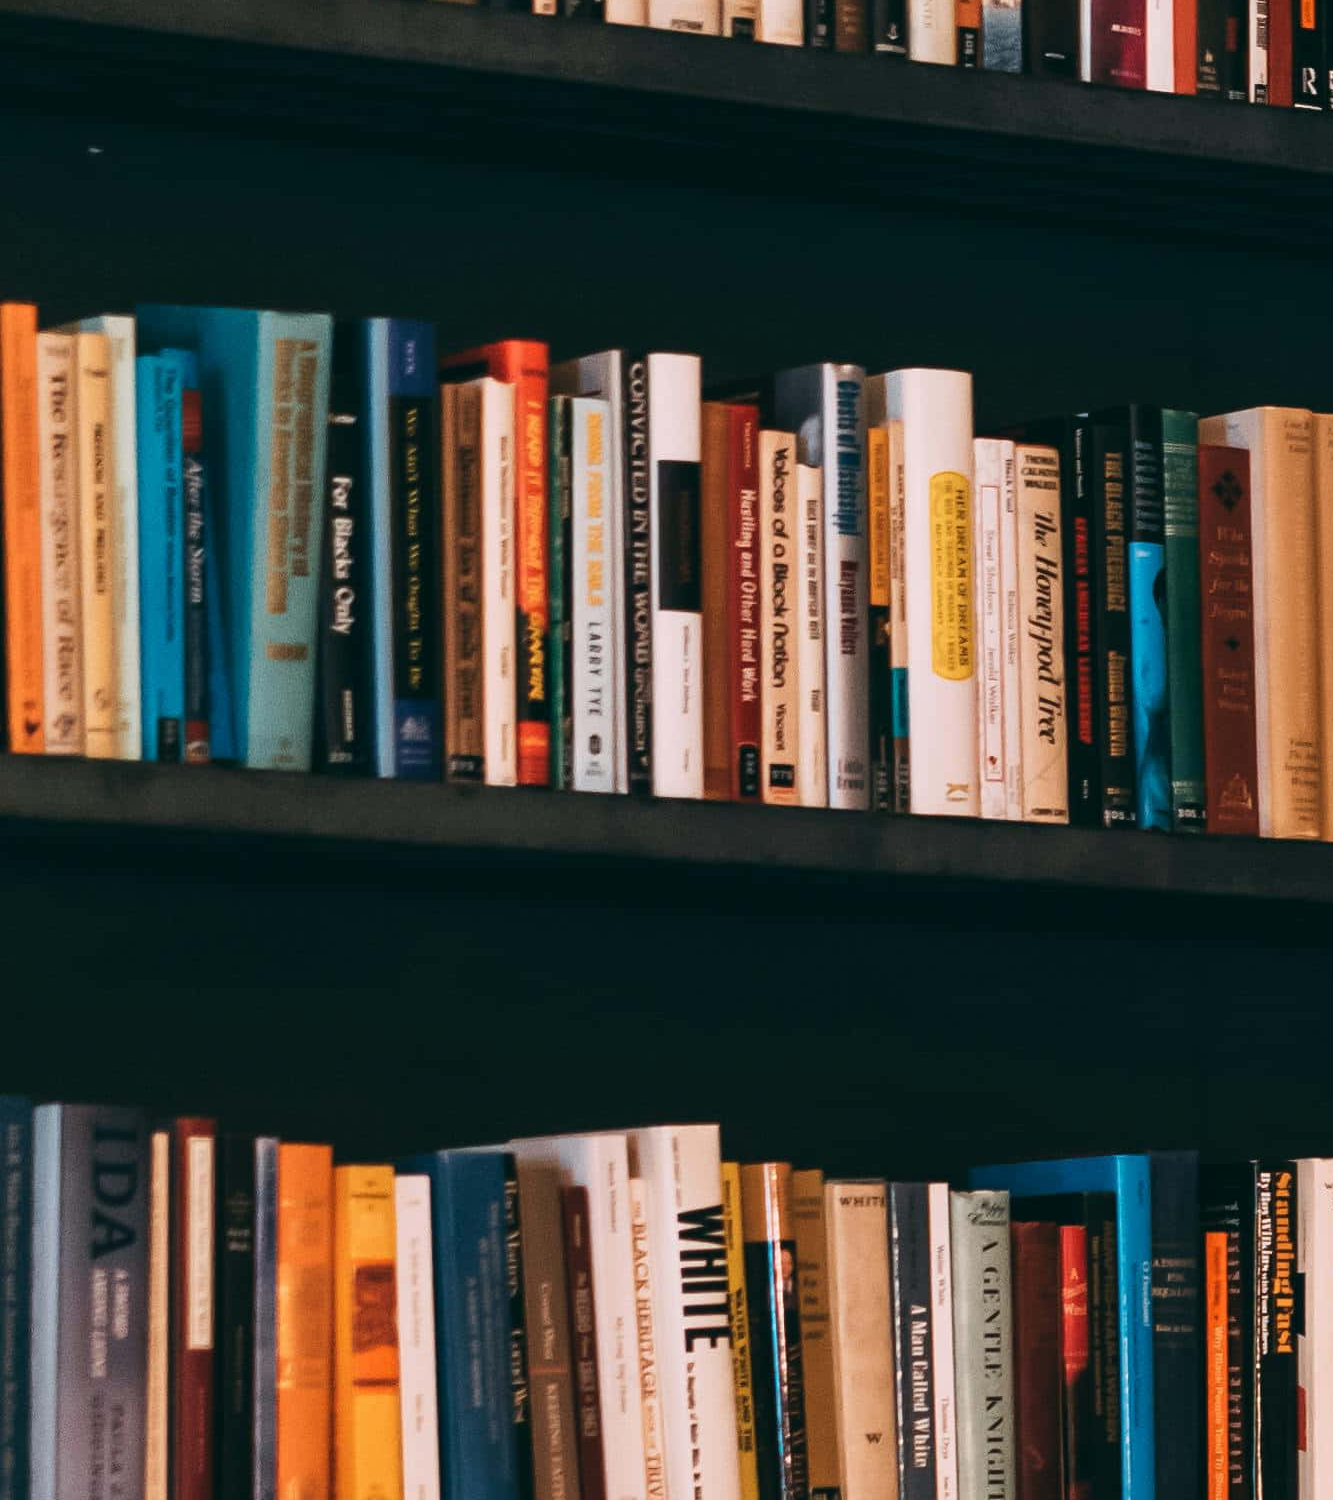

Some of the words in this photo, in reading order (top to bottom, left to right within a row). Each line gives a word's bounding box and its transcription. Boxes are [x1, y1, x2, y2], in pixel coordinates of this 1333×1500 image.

[334, 476, 354, 510] For
[772, 449, 789, 514] Voices
[332, 516, 354, 580] Blacks
[772, 519, 789, 540] of
[772, 544, 785, 559] a
[1035, 512, 1056, 548] The
[330, 586, 354, 635] Only
[771, 564, 789, 618] Black
[1030, 554, 1059, 691] Honey-pod
[772, 622, 789, 689] Nation
[1038, 697, 1061, 745] Tree
[982, 1238, 998, 1255] A
[981, 1267, 1002, 1378] GENTLE
